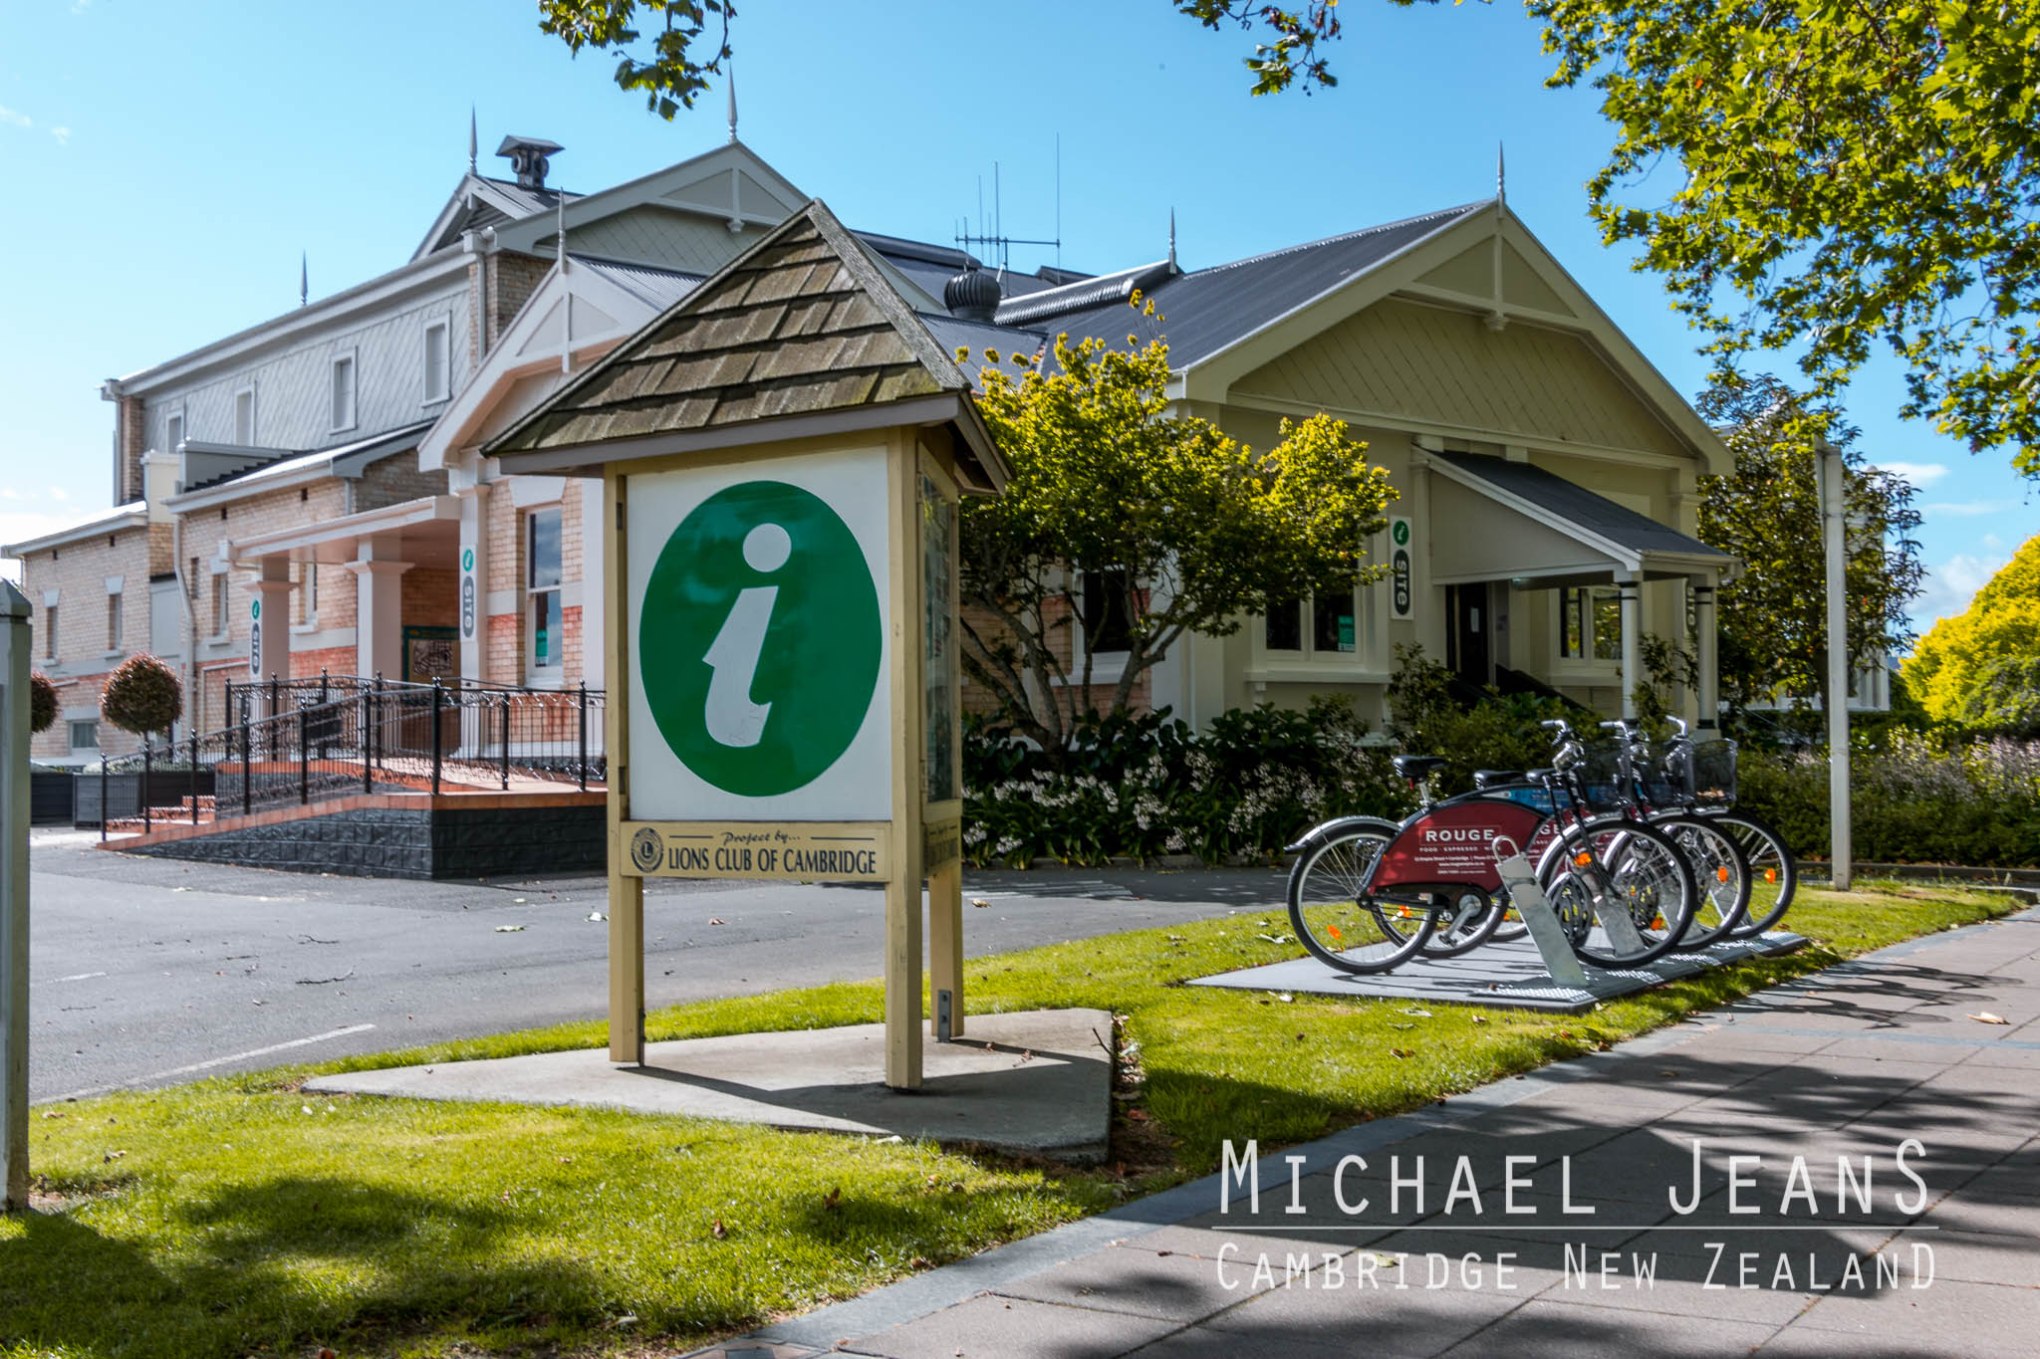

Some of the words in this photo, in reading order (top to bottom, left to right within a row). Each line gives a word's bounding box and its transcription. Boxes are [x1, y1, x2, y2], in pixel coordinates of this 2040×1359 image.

[720, 831, 770, 846] Project
[1425, 829, 1495, 842] ROUGE
[668, 847, 710, 870] LIONS
[715, 847, 752, 871] CLUB
[757, 848, 778, 872] OF
[783, 849, 876, 874] CAMBRIDGE
